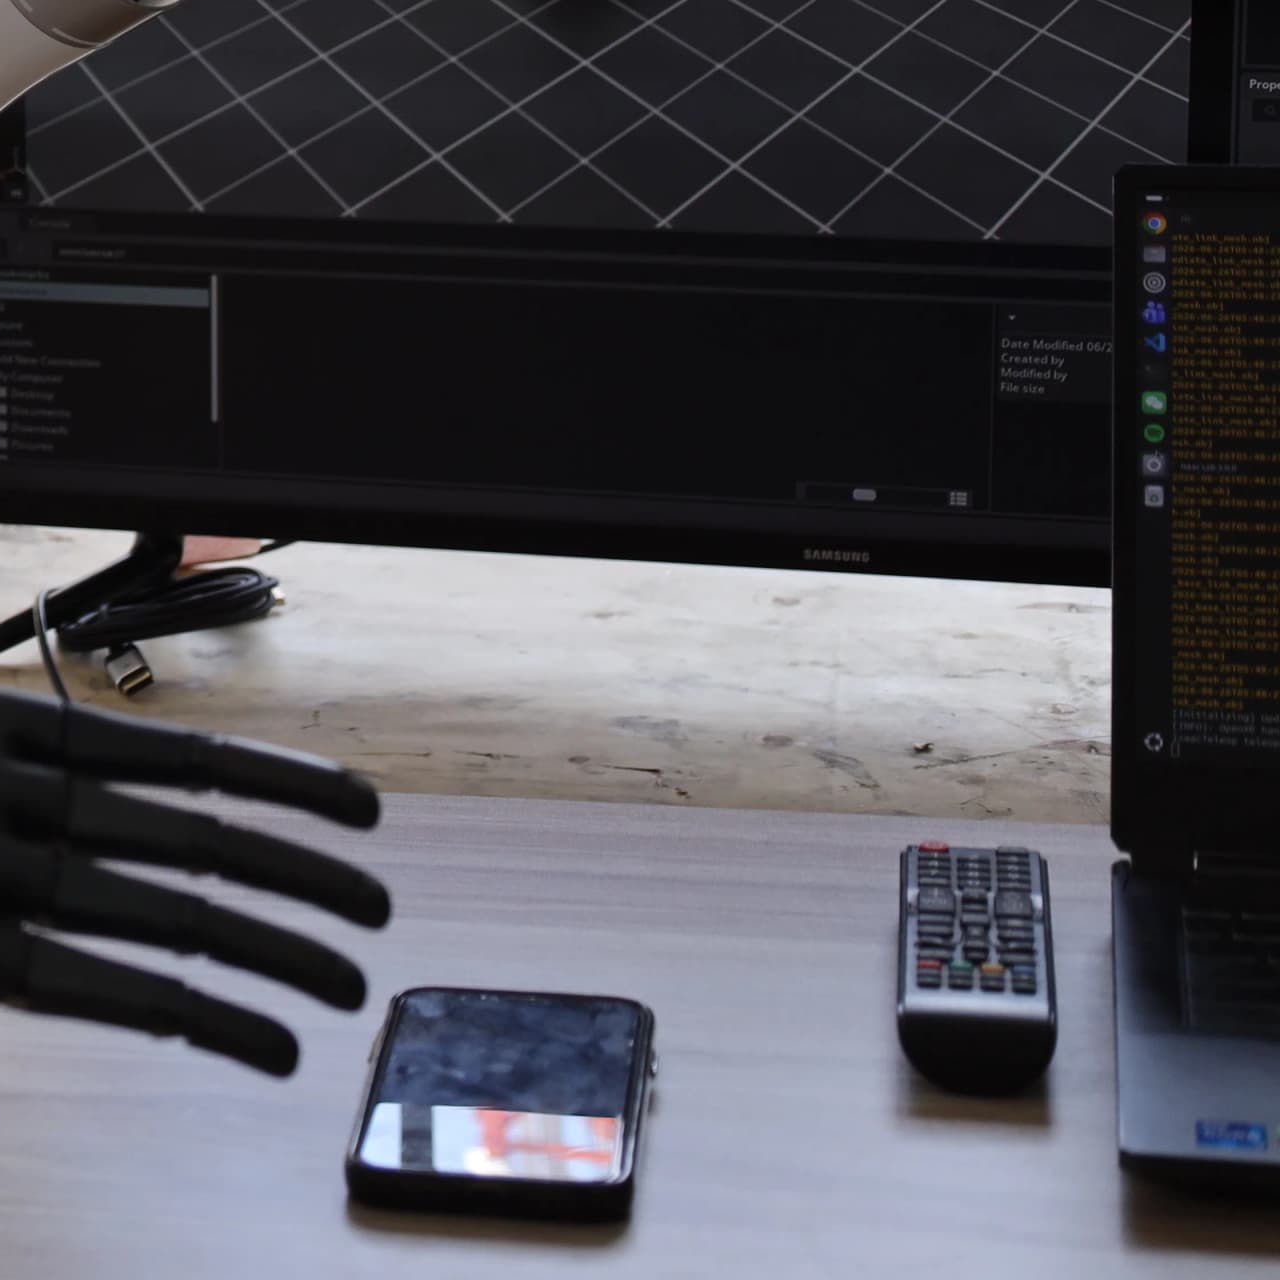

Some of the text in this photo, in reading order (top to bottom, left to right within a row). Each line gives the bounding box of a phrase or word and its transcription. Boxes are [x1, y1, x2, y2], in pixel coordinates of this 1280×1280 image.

[1249, 78, 1280, 92] Prope
[1001, 337, 1113, 353] Date Modified 06/2
[1001, 352, 1065, 368] Created by
[1001, 368, 1068, 383] Modified by
[1000, 381, 1046, 394] File size
[803, 548, 870, 563] SAMSUNG
